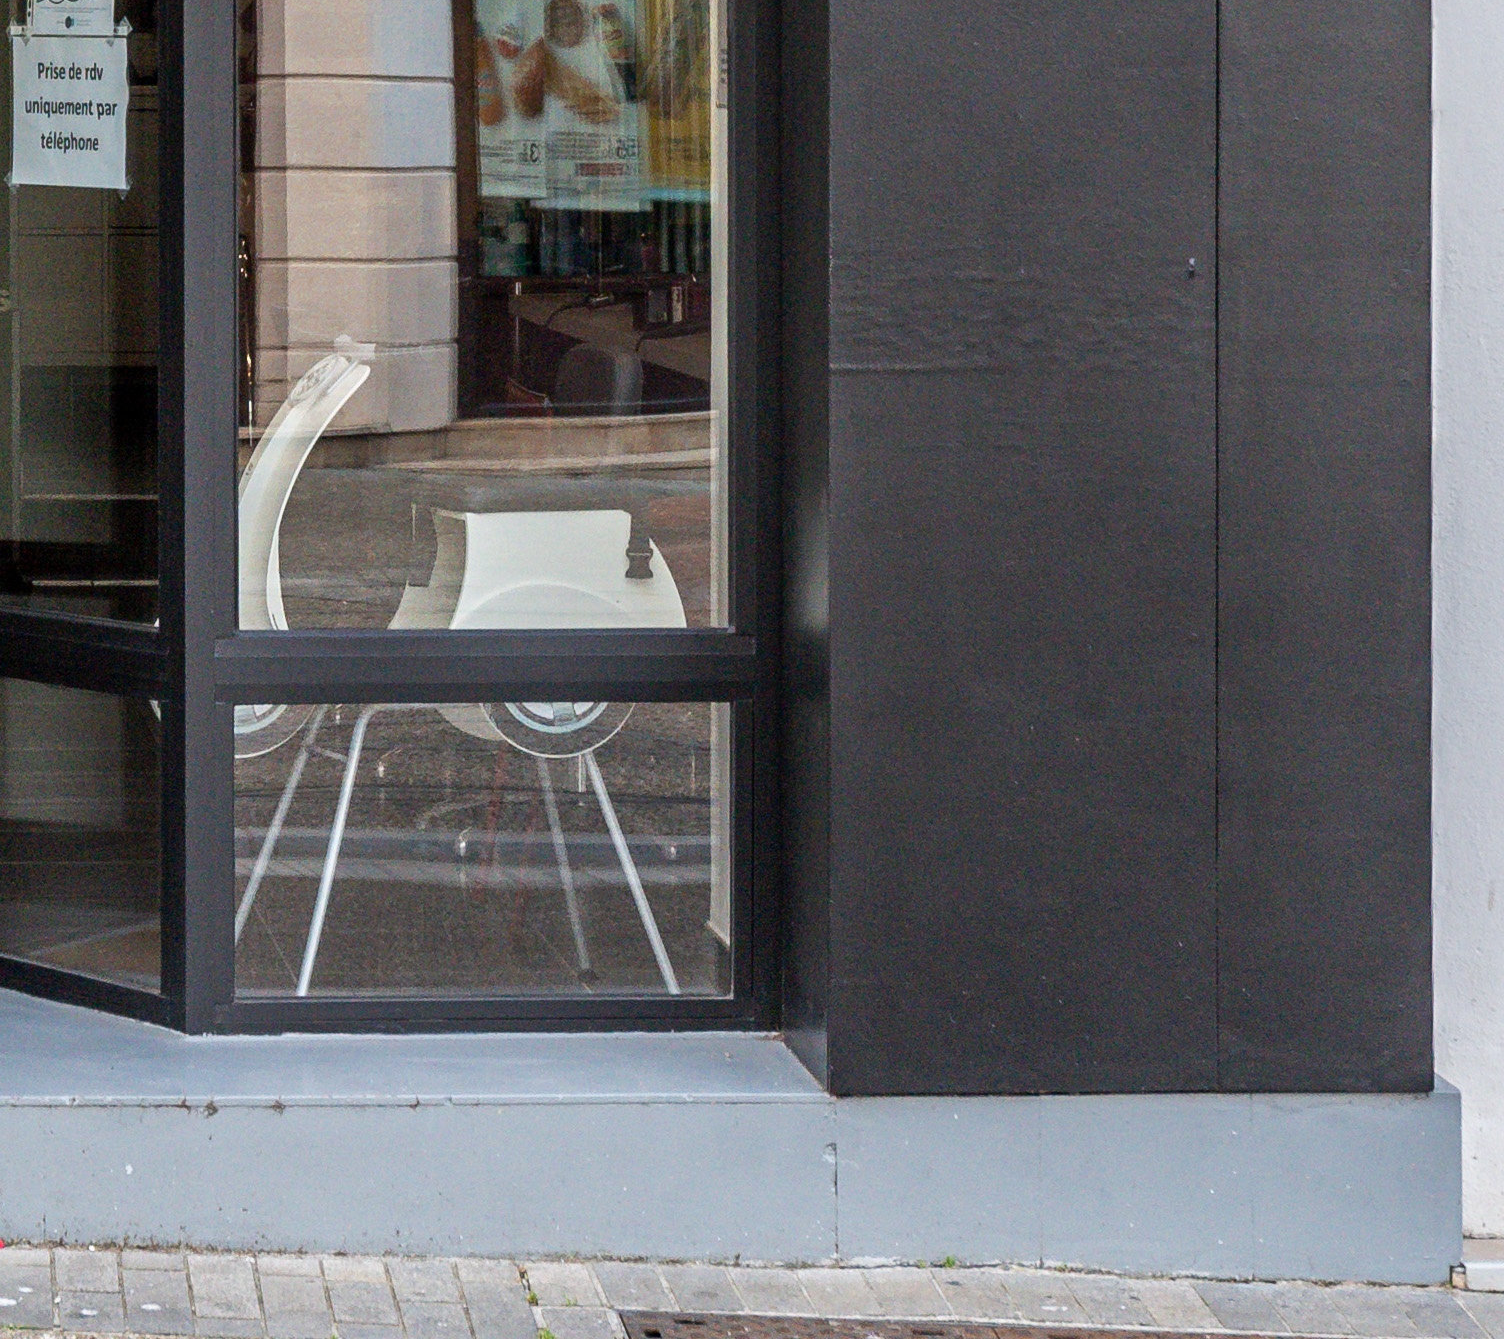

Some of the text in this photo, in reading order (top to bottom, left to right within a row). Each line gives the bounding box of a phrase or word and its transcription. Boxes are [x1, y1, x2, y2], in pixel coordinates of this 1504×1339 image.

[36, 61, 105, 81] Prise de rdv
[24, 98, 118, 119] uniquement par
[39, 134, 100, 152] téléphone
